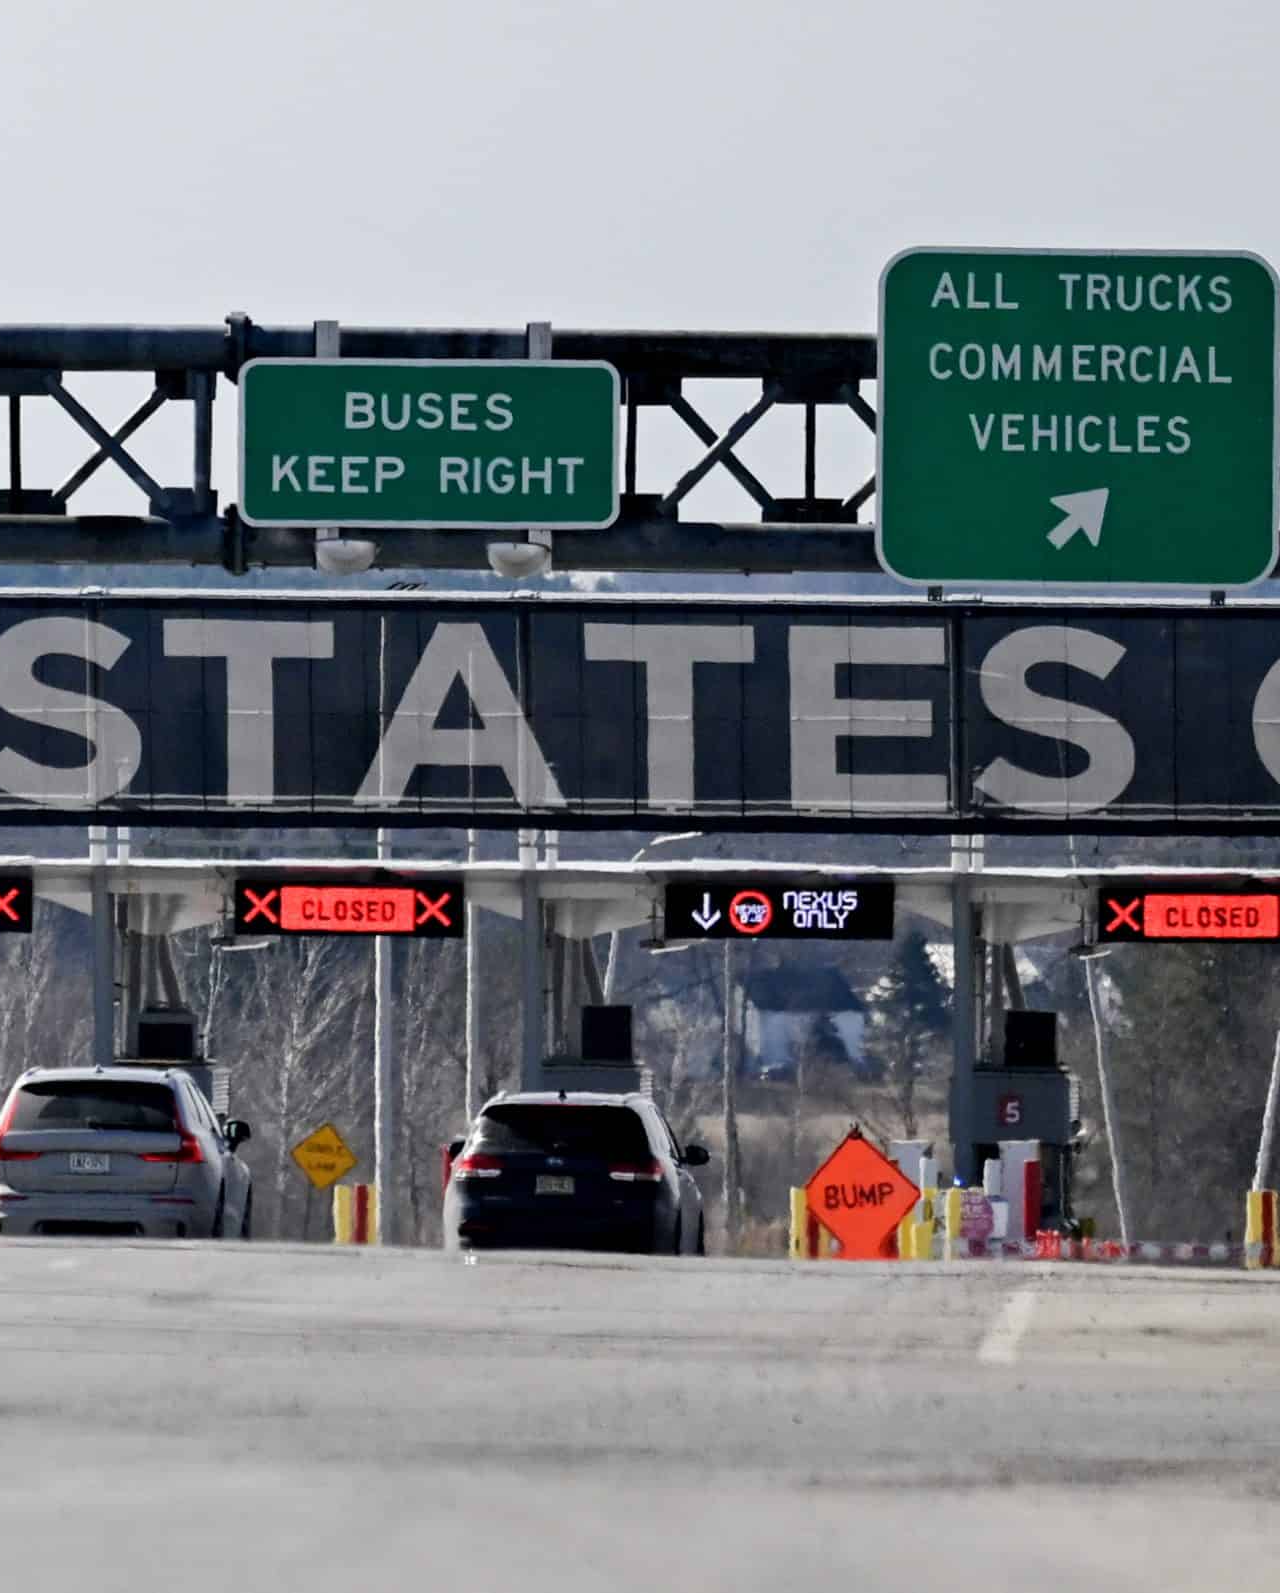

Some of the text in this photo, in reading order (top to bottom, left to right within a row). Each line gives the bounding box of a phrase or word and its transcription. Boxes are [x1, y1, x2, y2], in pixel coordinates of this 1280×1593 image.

[931, 271, 1233, 313] ALL TRUCKS
[929, 342, 1233, 384] COMMERCIAL
[344, 391, 514, 431] BUSES
[969, 413, 1191, 454] VEHICLES
[272, 455, 585, 495] KEEP RIGHT
[301, 899, 396, 922] CLOSED
[783, 891, 858, 910] NEXUS
[793, 910, 849, 929] ONLY
[1166, 906, 1260, 928] CLOSED
[1006, 1100, 1020, 1123] 5
[824, 1182, 894, 1210] BUMP
